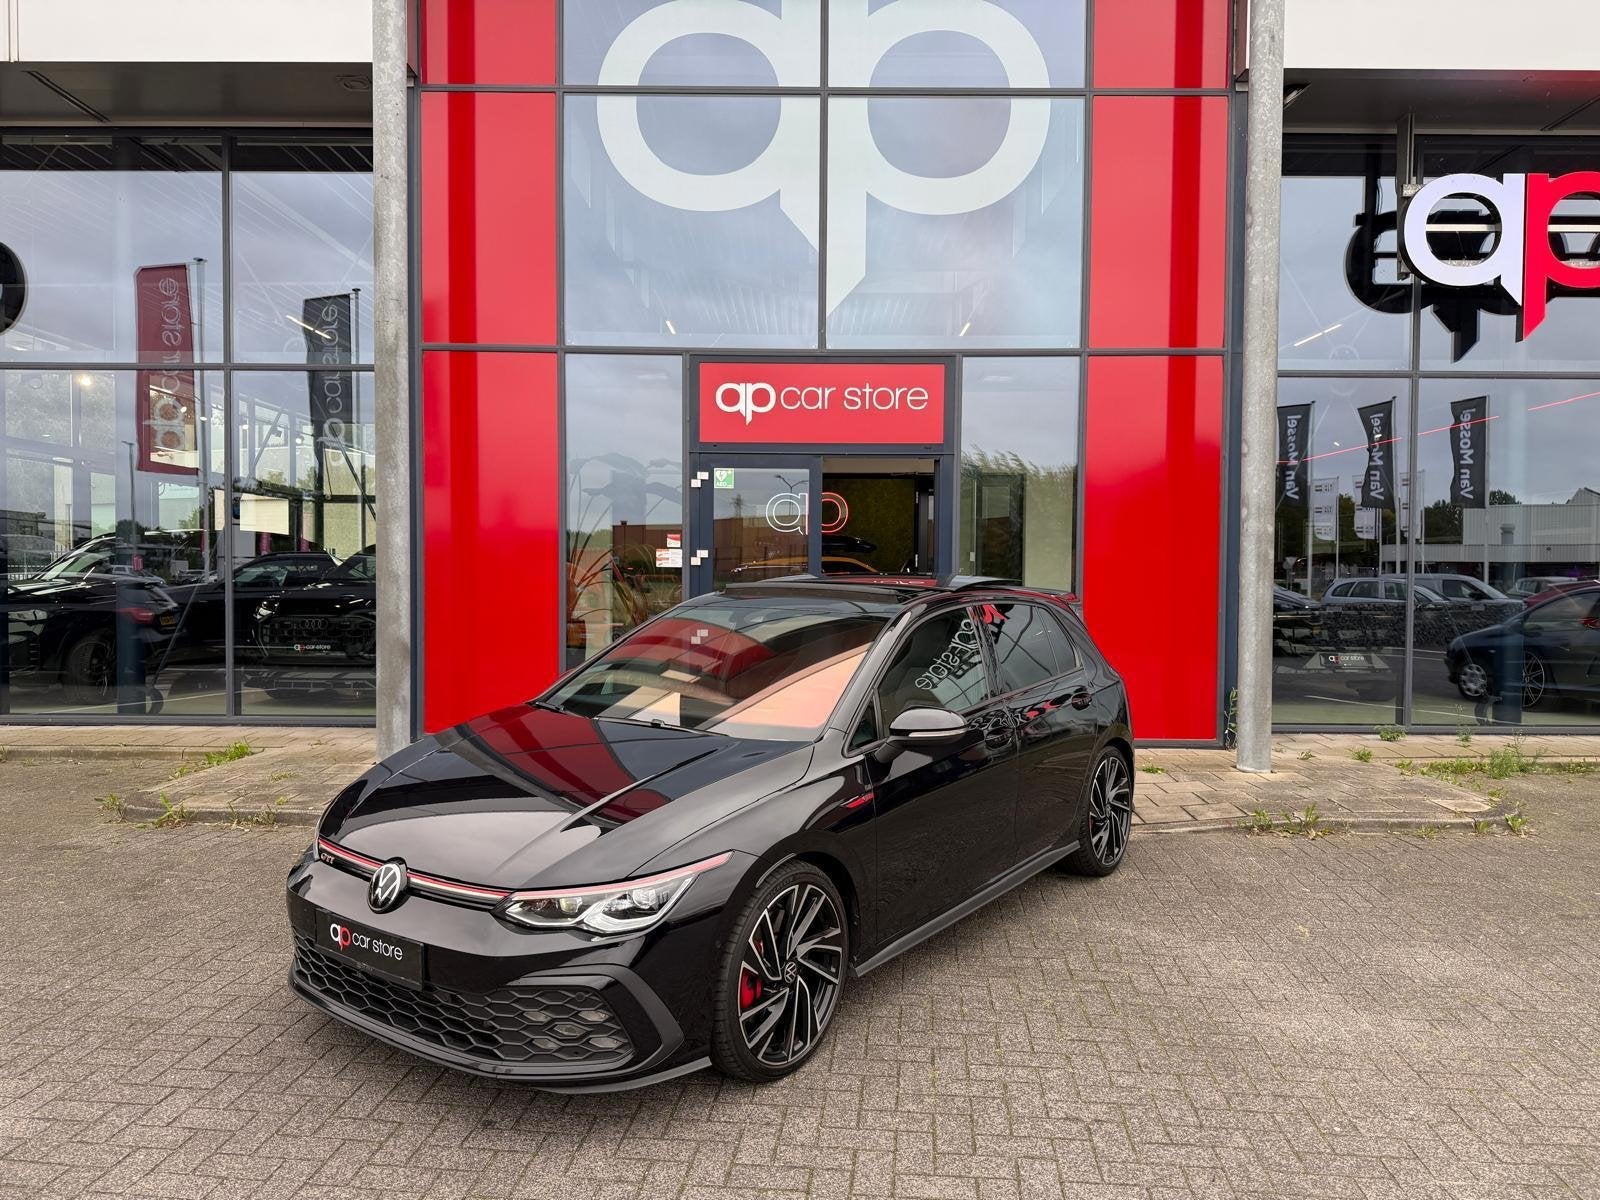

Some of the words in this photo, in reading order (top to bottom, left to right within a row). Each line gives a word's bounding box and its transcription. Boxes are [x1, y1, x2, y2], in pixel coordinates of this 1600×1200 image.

[780, 386, 836, 410] car
[843, 382, 929, 410] store
[352, 932, 370, 949] car
[372, 939, 403, 961] store
